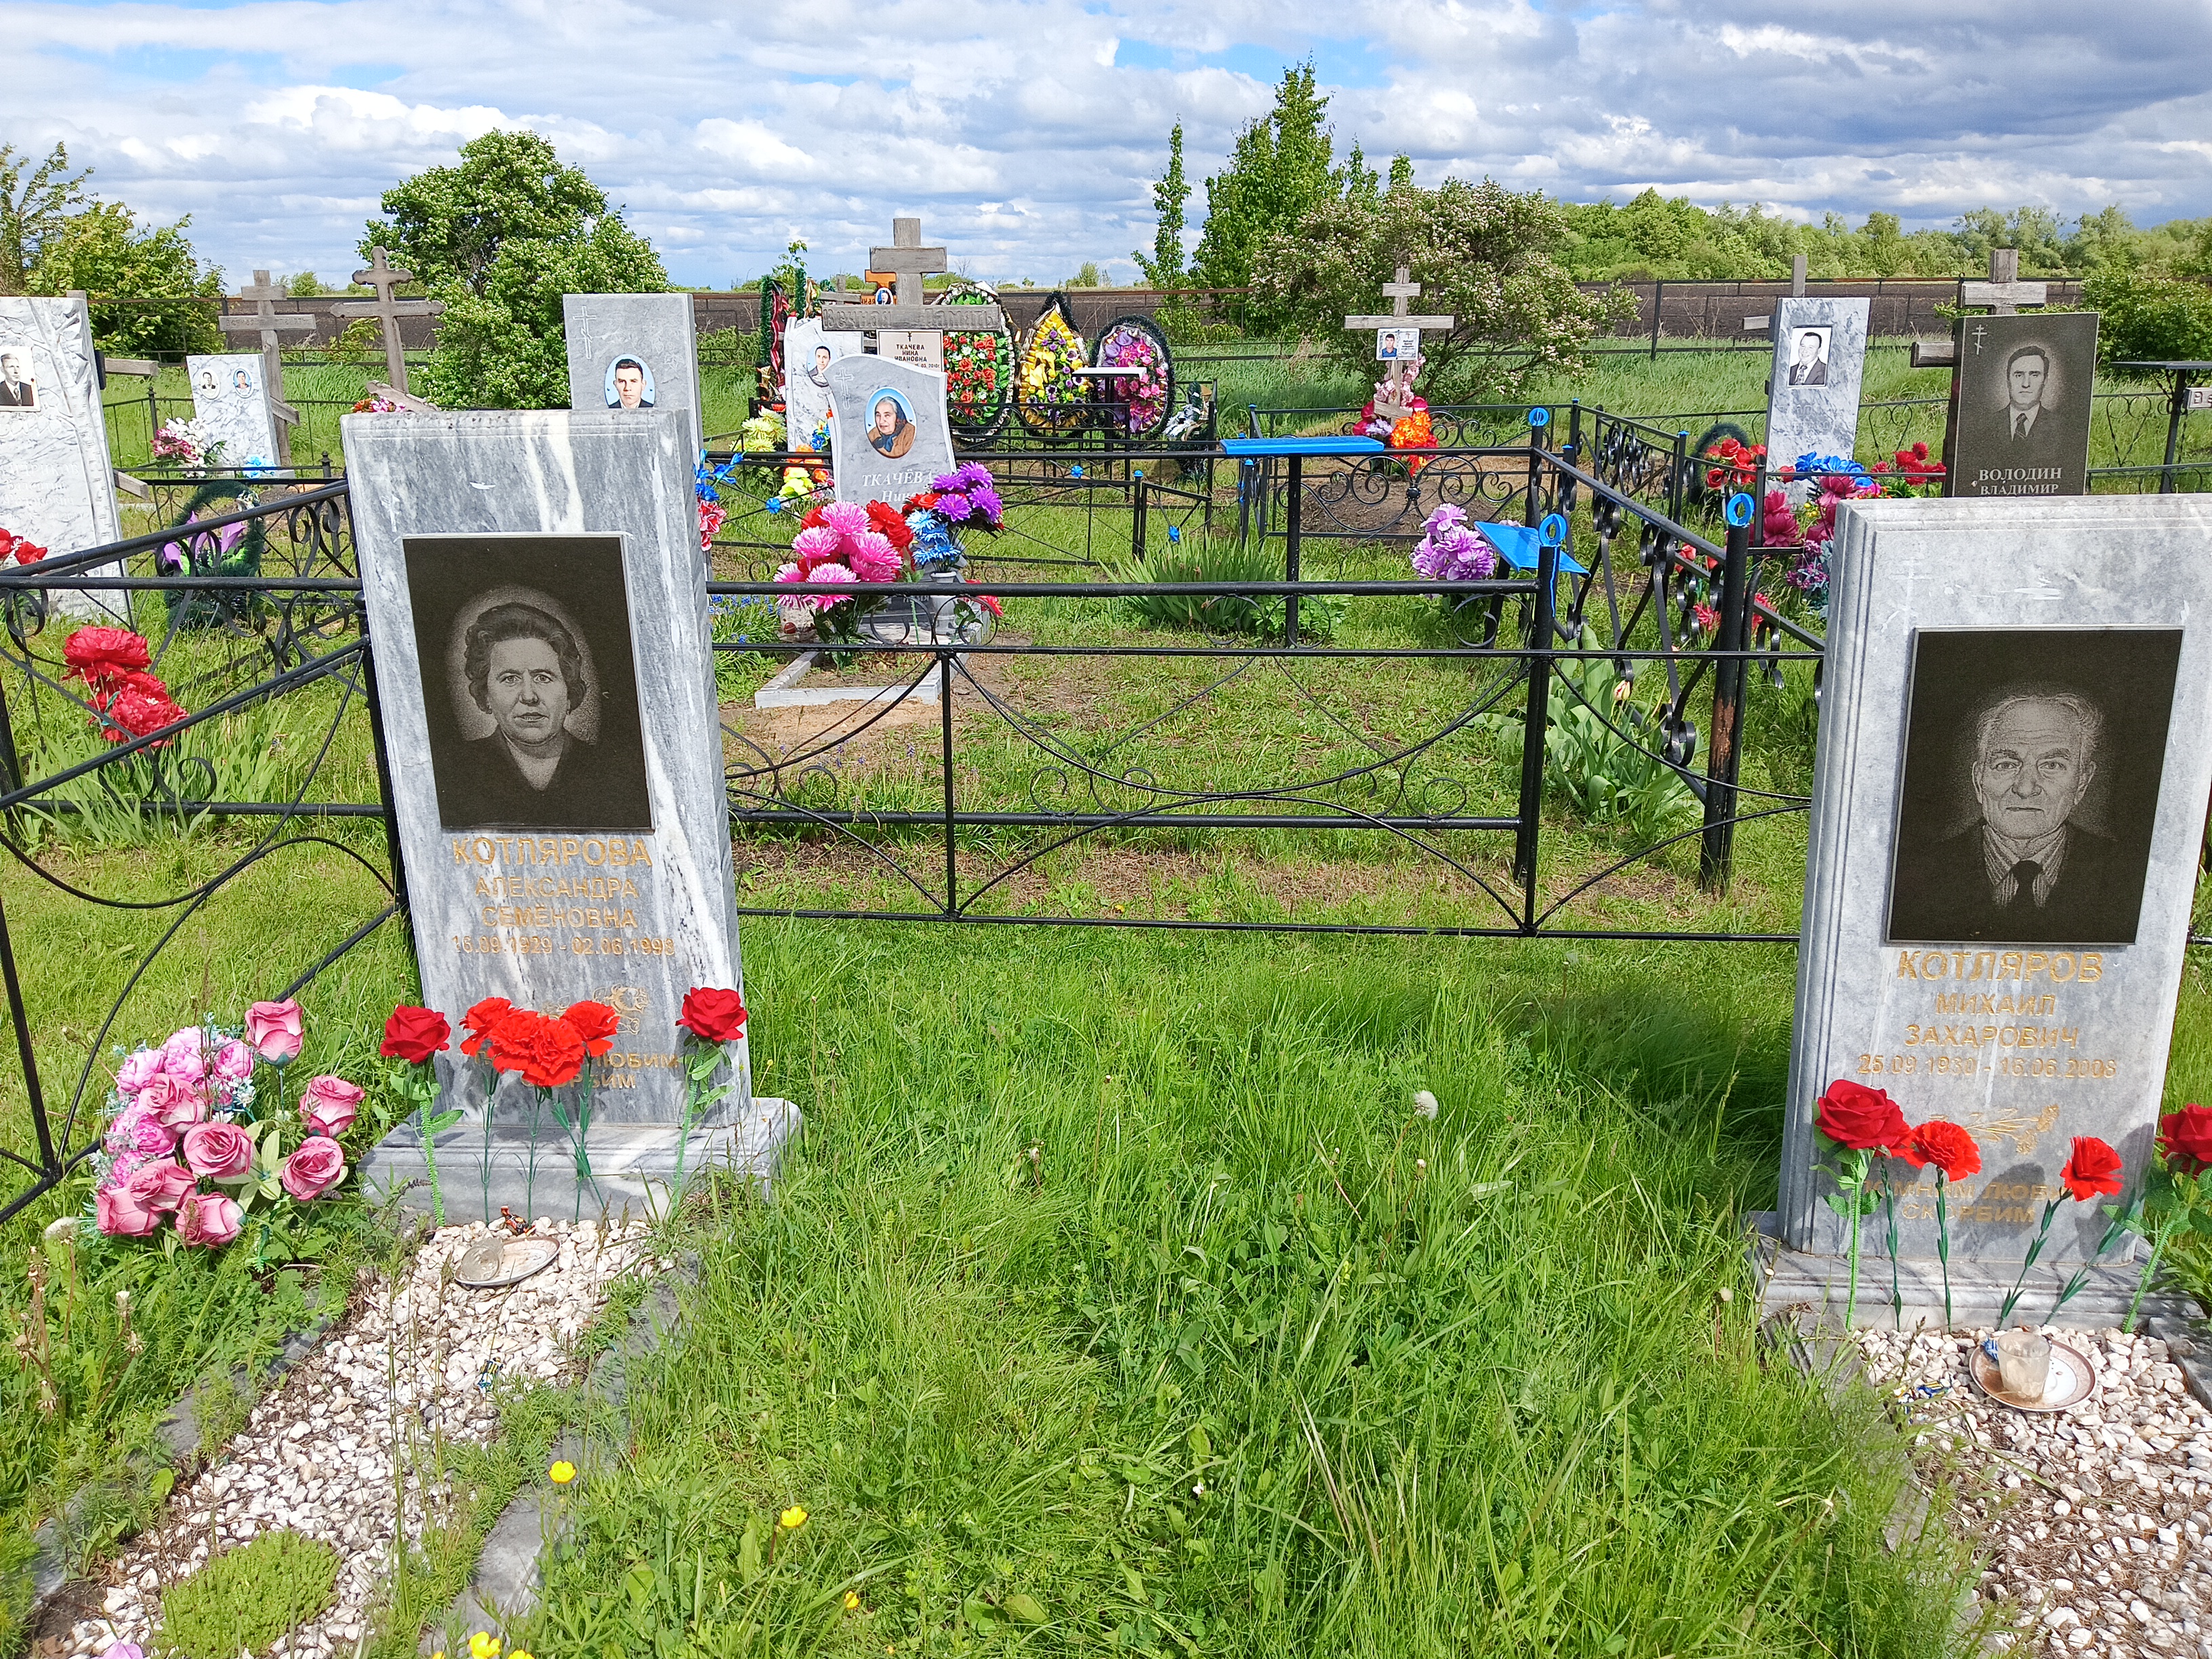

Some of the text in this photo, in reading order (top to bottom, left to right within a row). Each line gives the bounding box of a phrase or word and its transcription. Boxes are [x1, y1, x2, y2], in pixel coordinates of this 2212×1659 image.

[862, 469, 934, 487] ТКАЧЁВА
[1979, 468, 2062, 482] ВОЛОДИН
[1980, 484, 2059, 495] ВЛАДИМИР
[452, 837, 653, 867] КОТЛЯРОВА
[475, 876, 638, 901] АЛЕКСАНДРА
[481, 904, 638, 928] СЕМЁНОВНА
[452, 935, 553, 954] 16.09.1929
[571, 937, 675, 956] 02.06.1998
[1897, 951, 2103, 983] КОТЛЯРОВ
[1935, 992, 2055, 1016] МИХАИЛ
[1904, 1024, 2078, 1050] ЗАХАРОВИЧ
[1857, 1054, 1978, 1076] 25.09.1930
[2000, 1057, 2117, 1079] 16.06.2008
